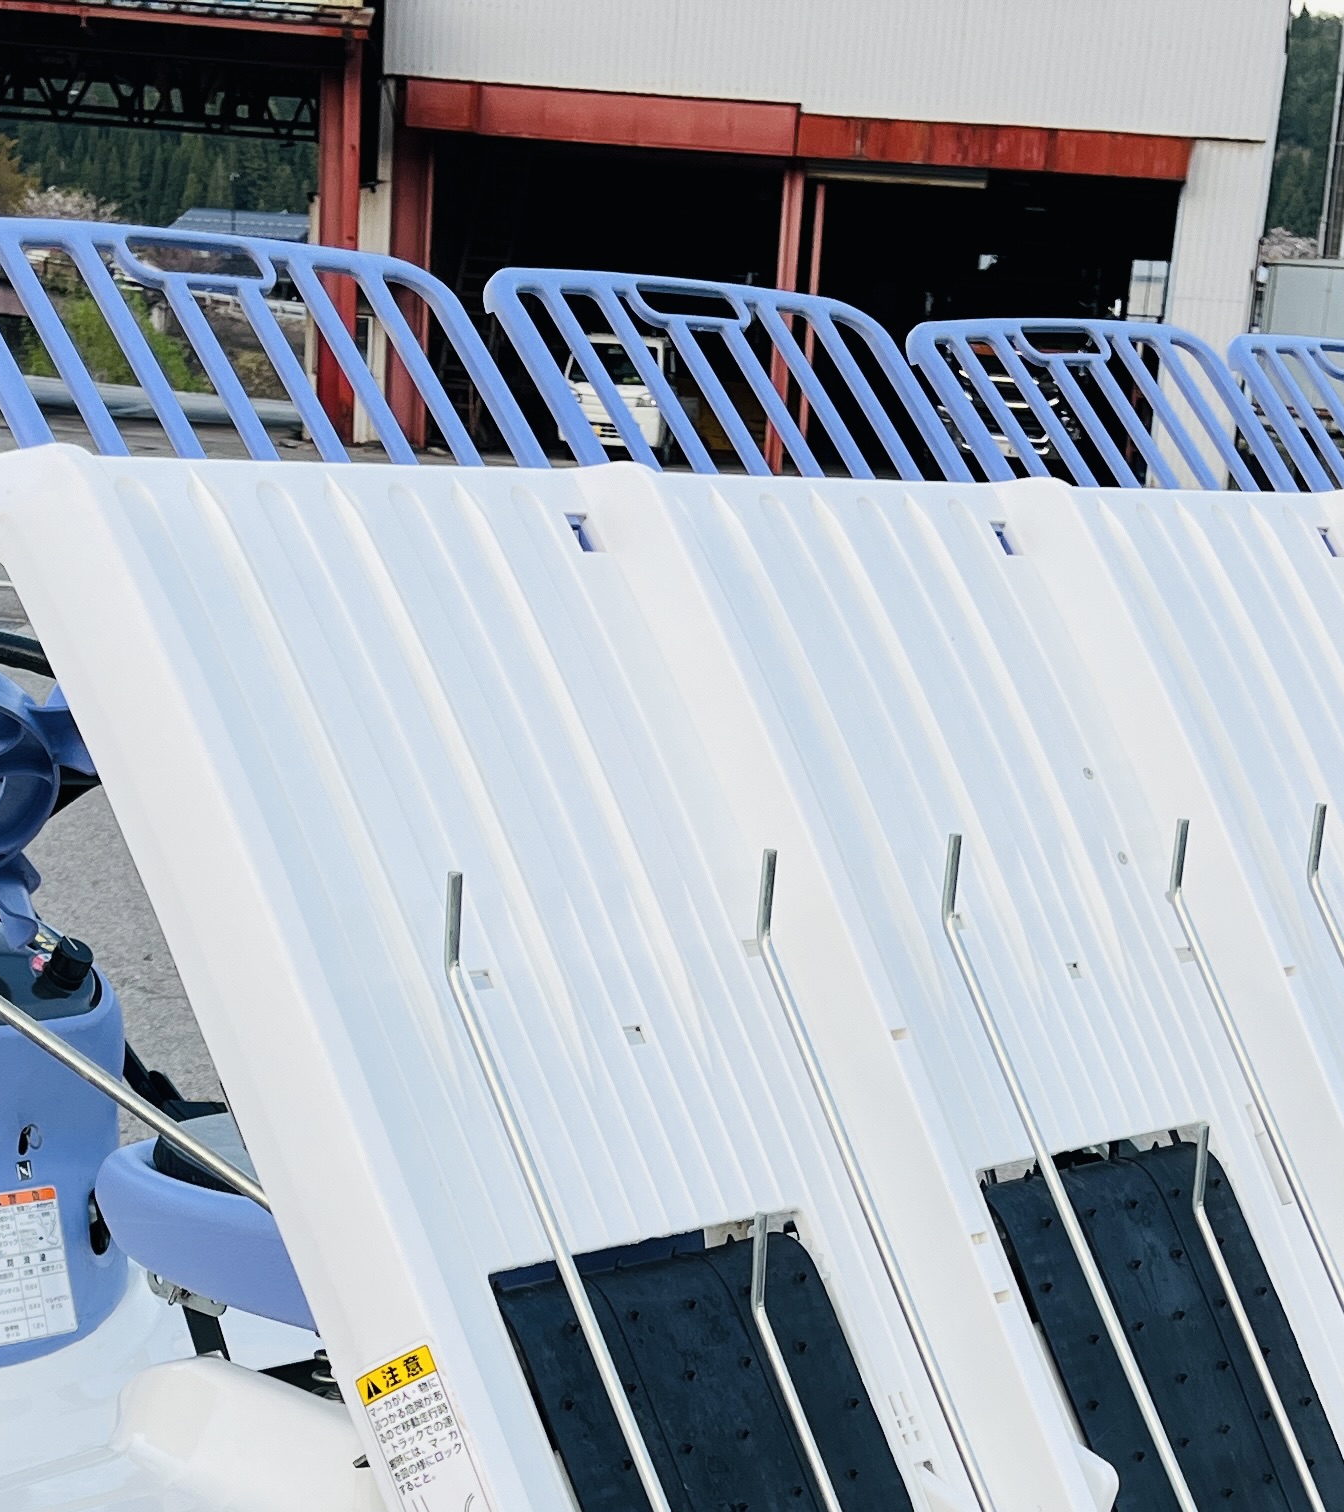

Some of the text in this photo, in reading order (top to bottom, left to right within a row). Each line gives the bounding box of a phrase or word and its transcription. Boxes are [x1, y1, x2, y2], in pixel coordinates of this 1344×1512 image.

[381, 1354, 424, 1389] 注意
[398, 1472, 437, 1496] すること。
